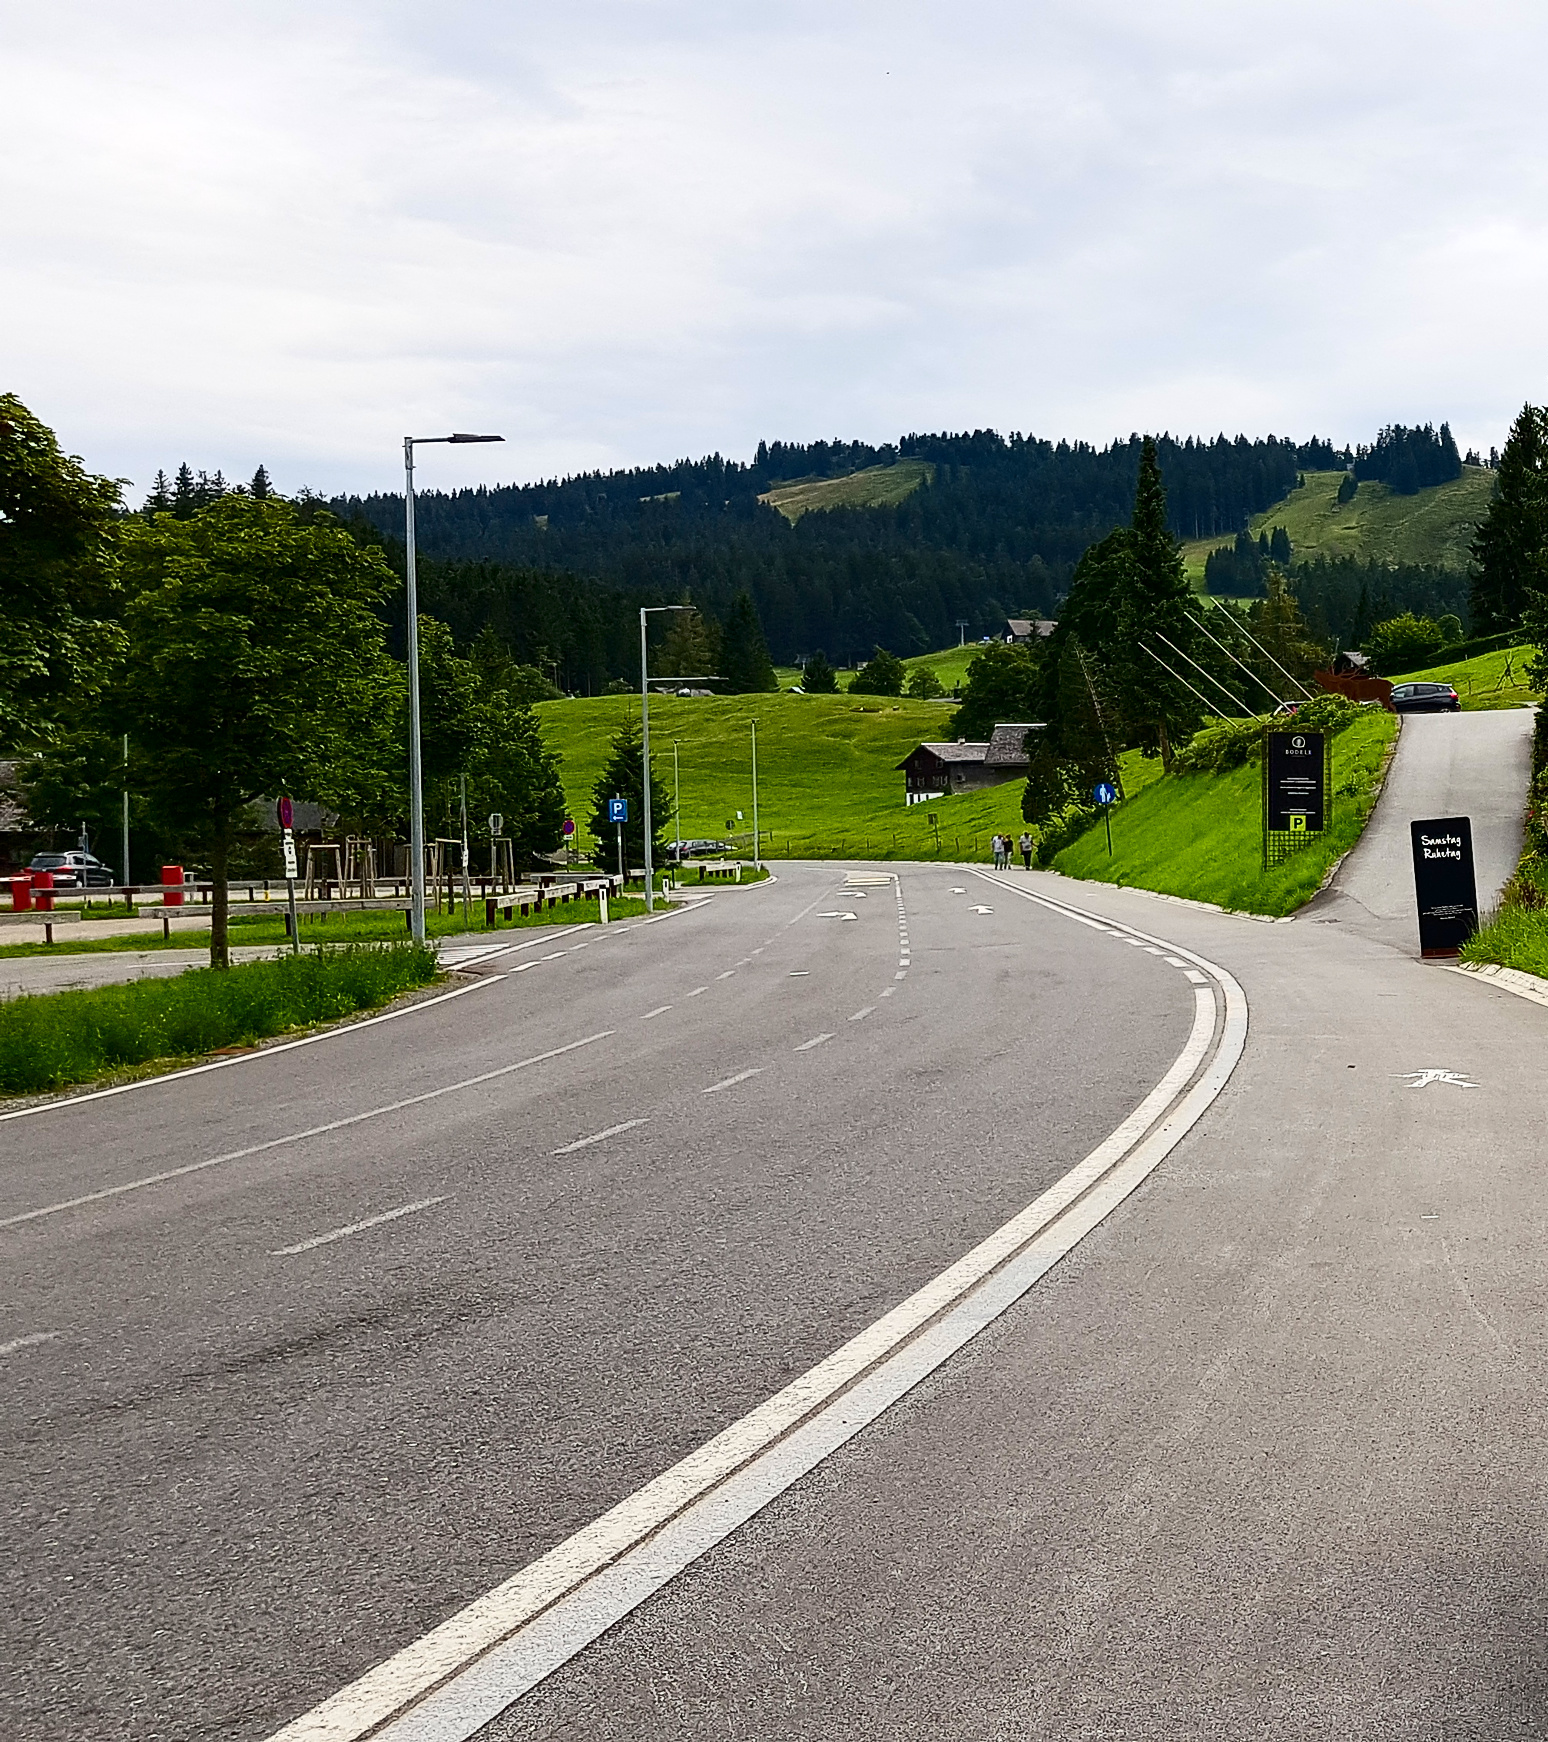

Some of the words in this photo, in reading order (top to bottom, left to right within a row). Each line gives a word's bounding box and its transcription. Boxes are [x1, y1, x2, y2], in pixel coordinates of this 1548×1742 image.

[613, 803, 622, 814] P
[1293, 817, 1303, 829] P
[1420, 833, 1462, 847] Samstag
[1422, 847, 1461, 861] Ruhetag
